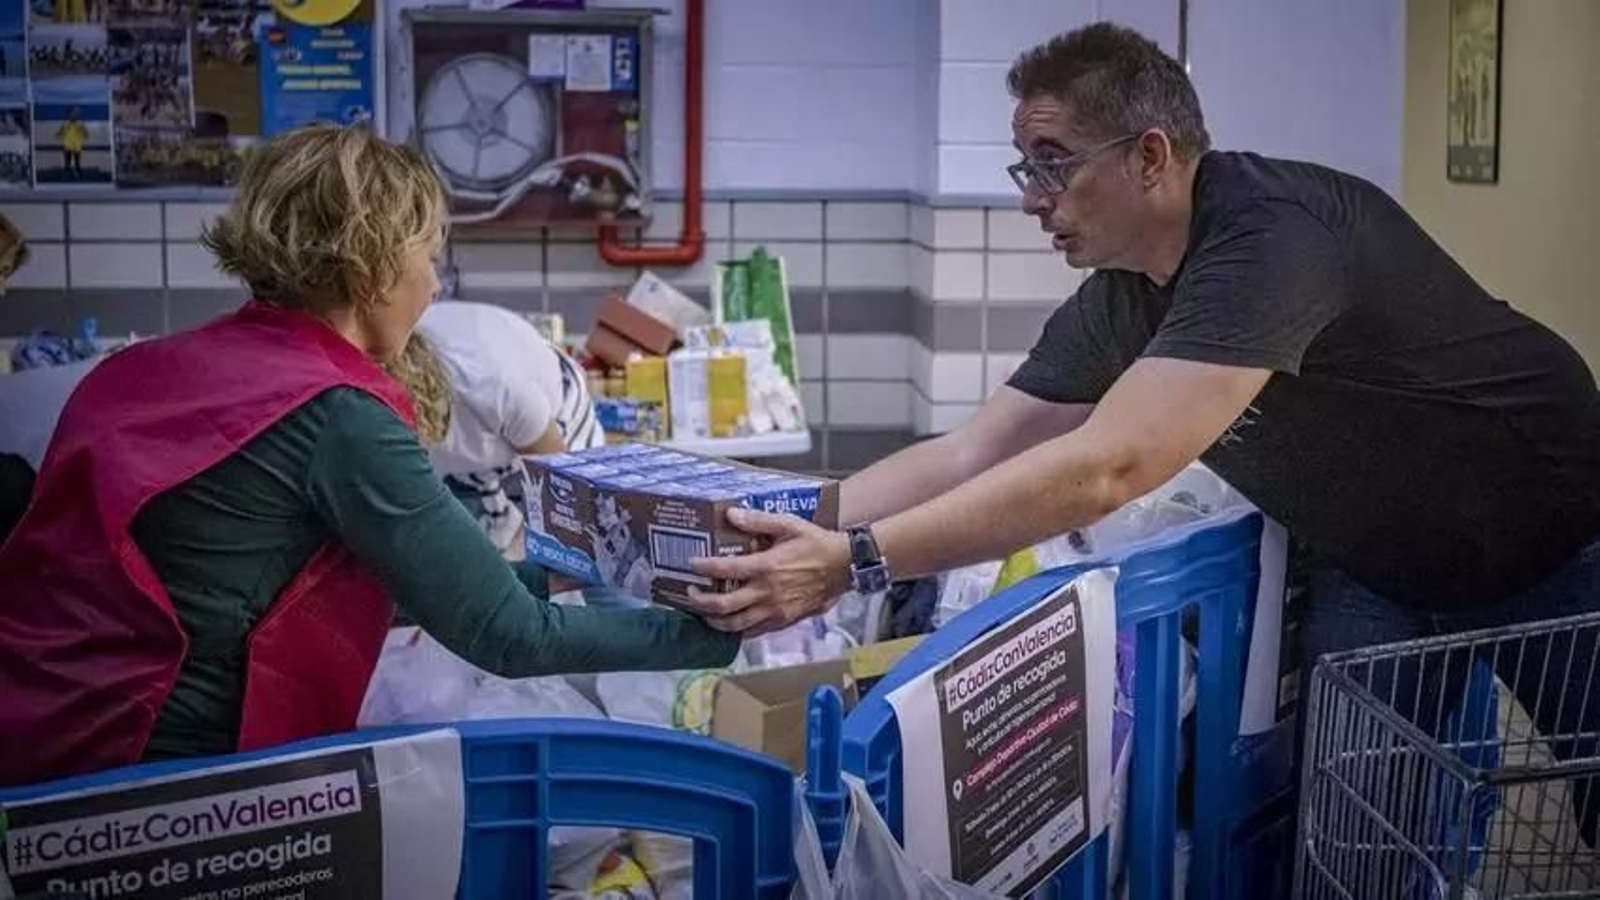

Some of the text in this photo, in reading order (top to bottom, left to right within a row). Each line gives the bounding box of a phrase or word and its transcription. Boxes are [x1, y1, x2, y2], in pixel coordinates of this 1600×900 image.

[763, 496, 818, 513] PULEVA
[949, 613, 1074, 707] #CádizConValencia
[962, 650, 1066, 731] Punto de recogida
[14, 783, 356, 866] #CádizConValencia
[150, 858, 189, 887] de
[197, 831, 331, 878] recogida
